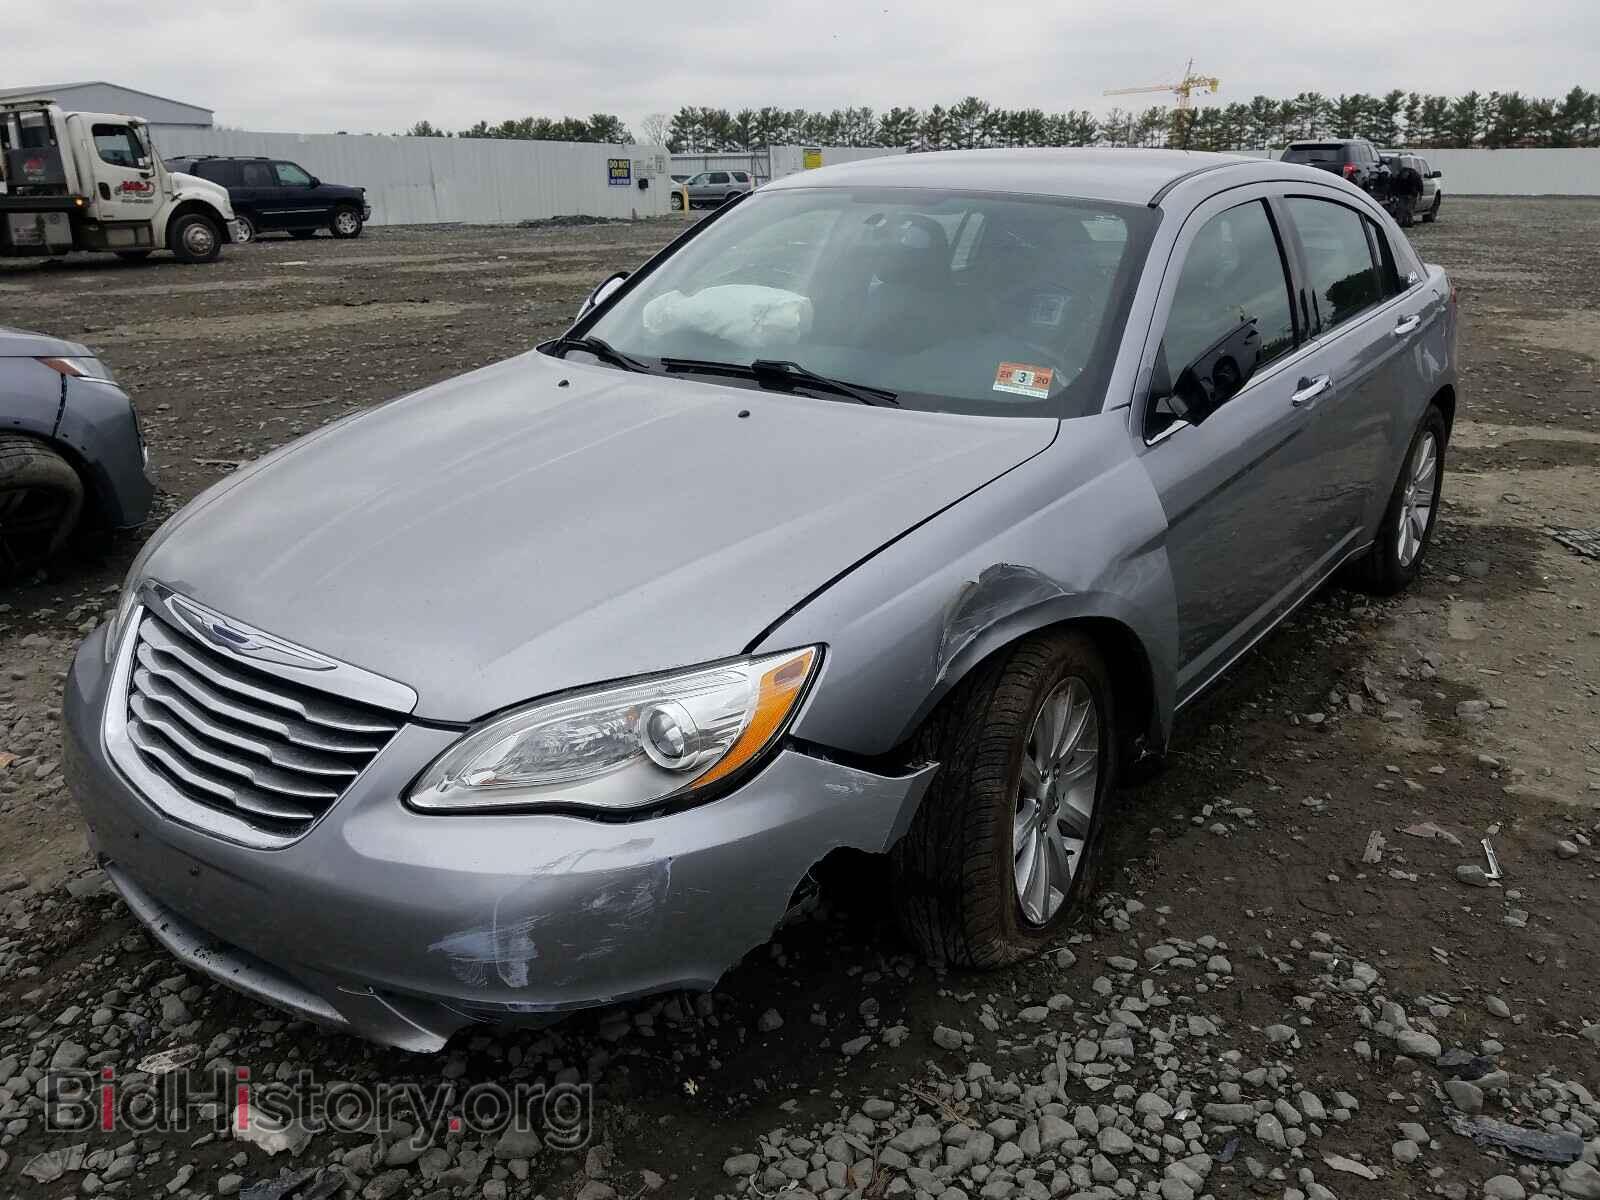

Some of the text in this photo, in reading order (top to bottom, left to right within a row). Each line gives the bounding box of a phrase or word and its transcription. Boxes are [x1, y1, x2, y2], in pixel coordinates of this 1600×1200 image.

[609, 160, 618, 169] DO
[1018, 372, 1027, 383] 3
[1035, 376, 1049, 385] 20
